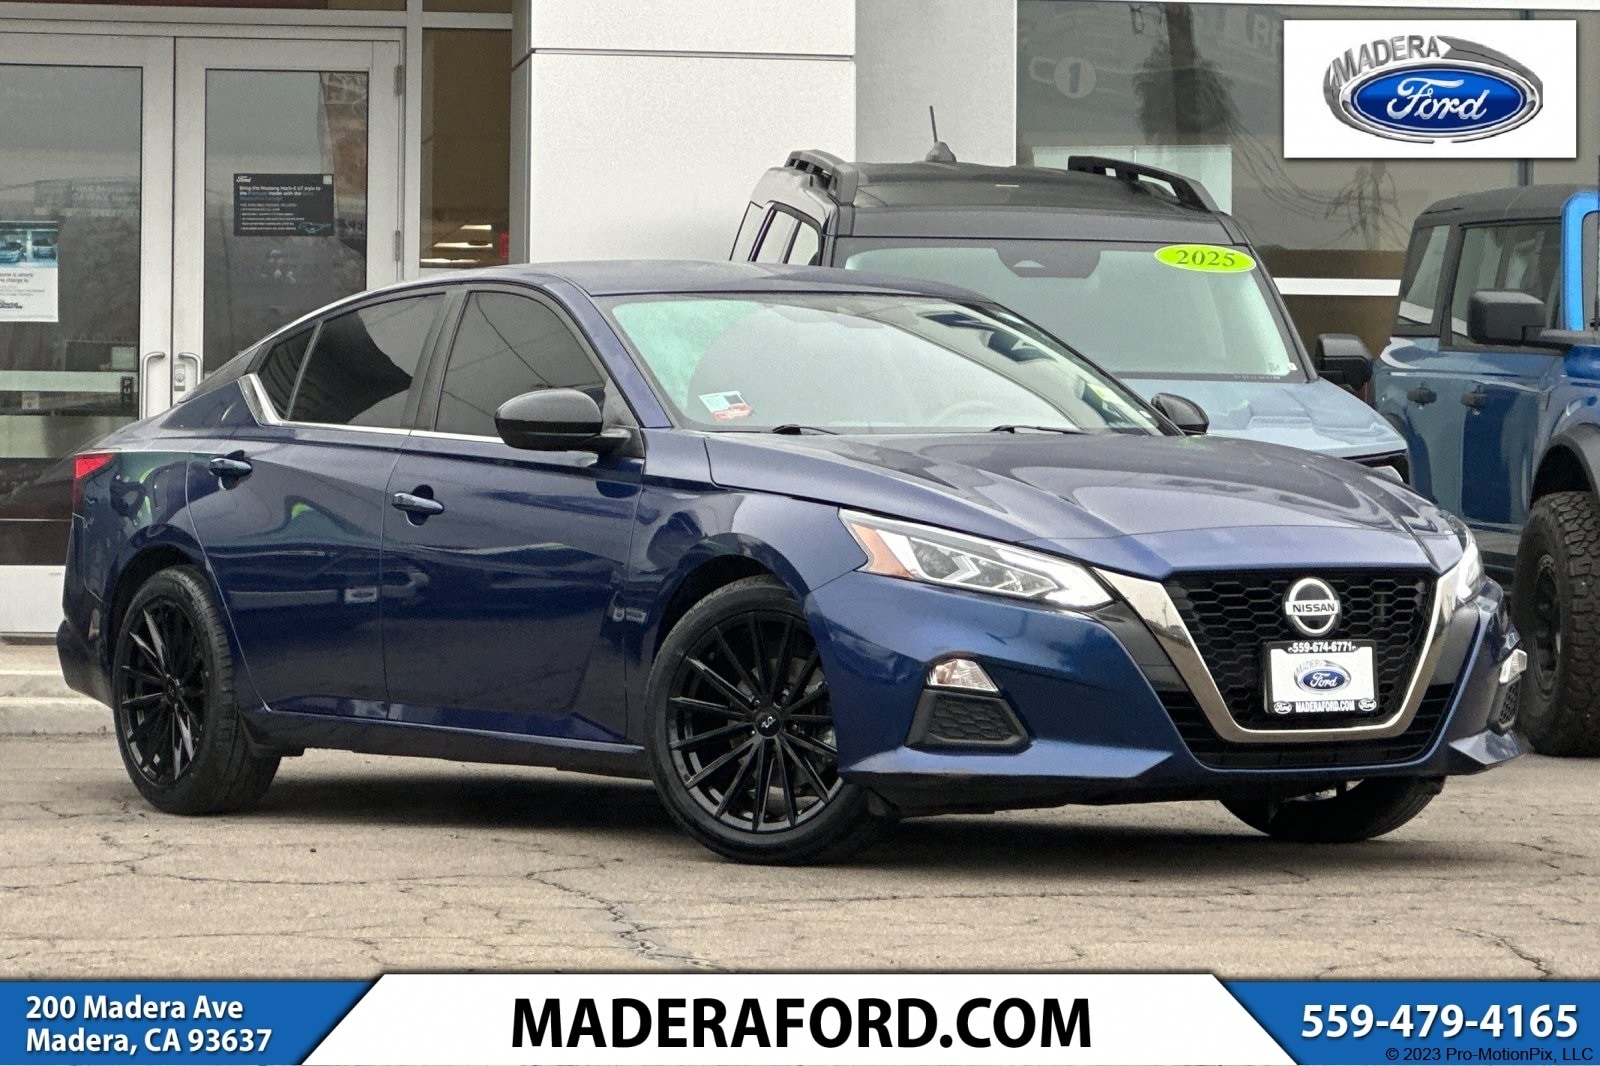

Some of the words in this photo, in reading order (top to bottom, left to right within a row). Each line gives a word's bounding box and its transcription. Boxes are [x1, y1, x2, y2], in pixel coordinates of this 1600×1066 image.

[1175, 249, 1236, 267] 2025
[1292, 603, 1335, 613] NISSAN
[1292, 641, 1352, 653] 559-674-6771
[1309, 671, 1338, 687] Ford
[1295, 700, 1356, 713] MADERAFORD.COM
